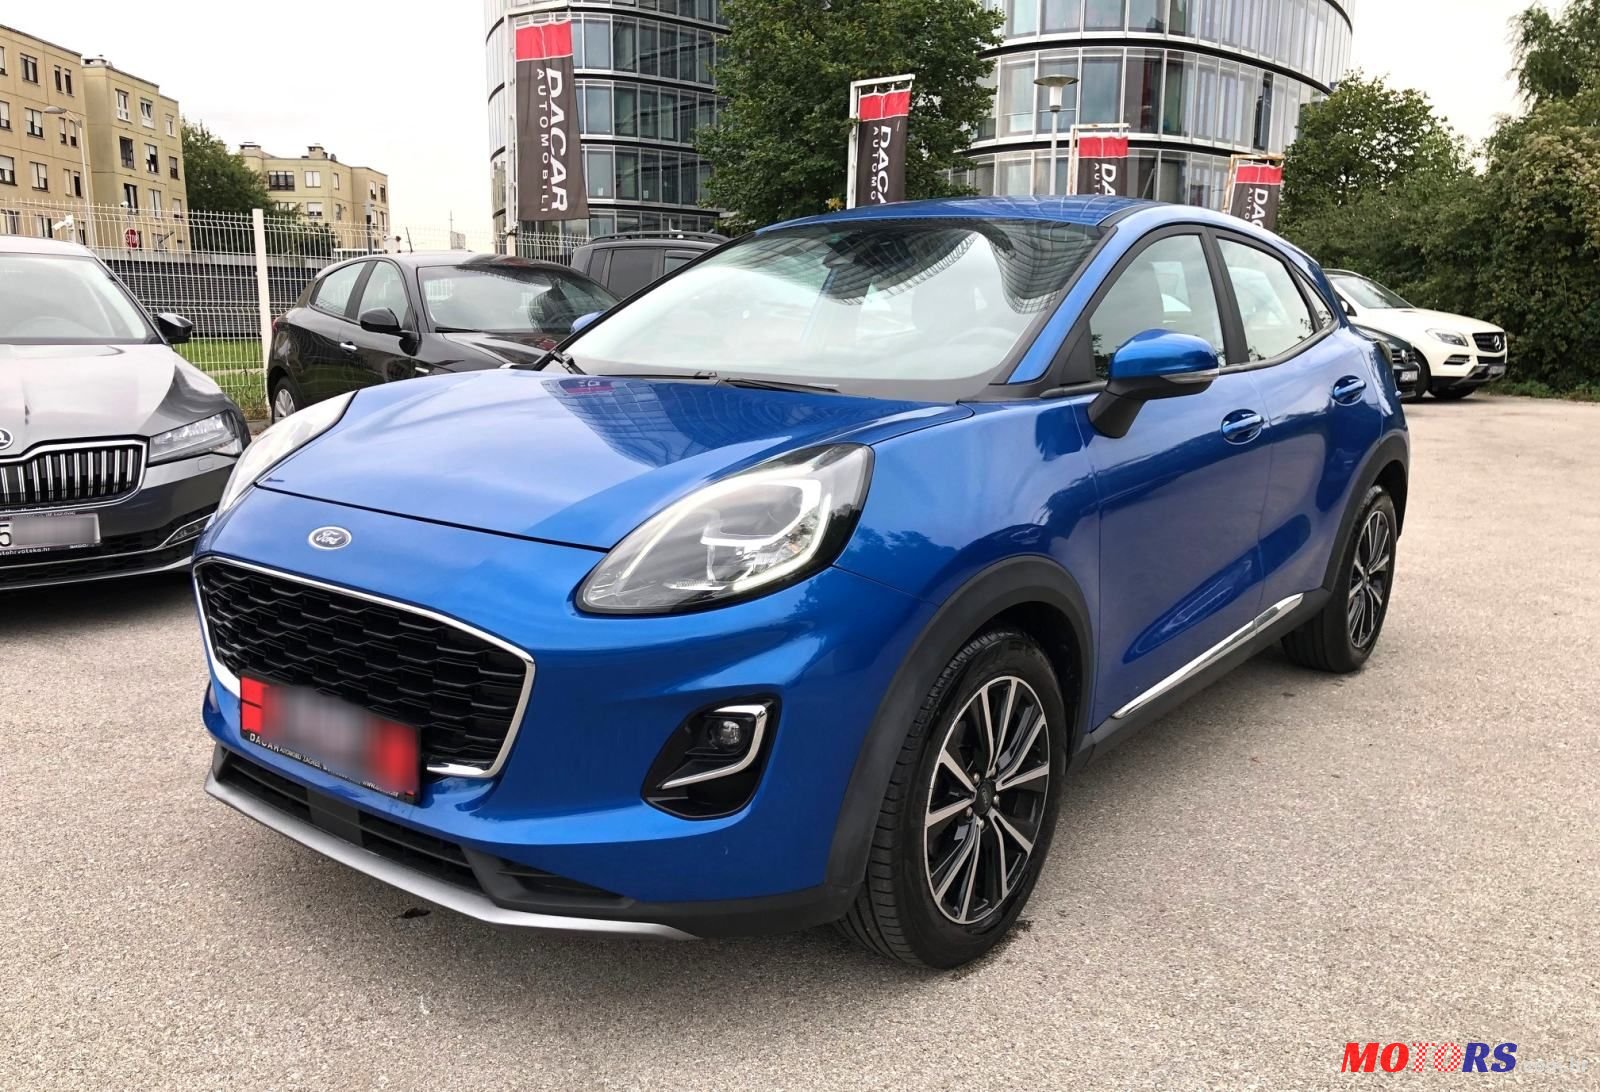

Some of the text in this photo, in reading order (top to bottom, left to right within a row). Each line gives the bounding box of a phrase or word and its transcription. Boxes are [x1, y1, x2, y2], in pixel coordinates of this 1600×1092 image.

[536, 68, 550, 212] AUTOMOBILI
[546, 67, 568, 212] DACAR
[1093, 162, 1101, 194] AUT
[316, 530, 342, 545] Ford
